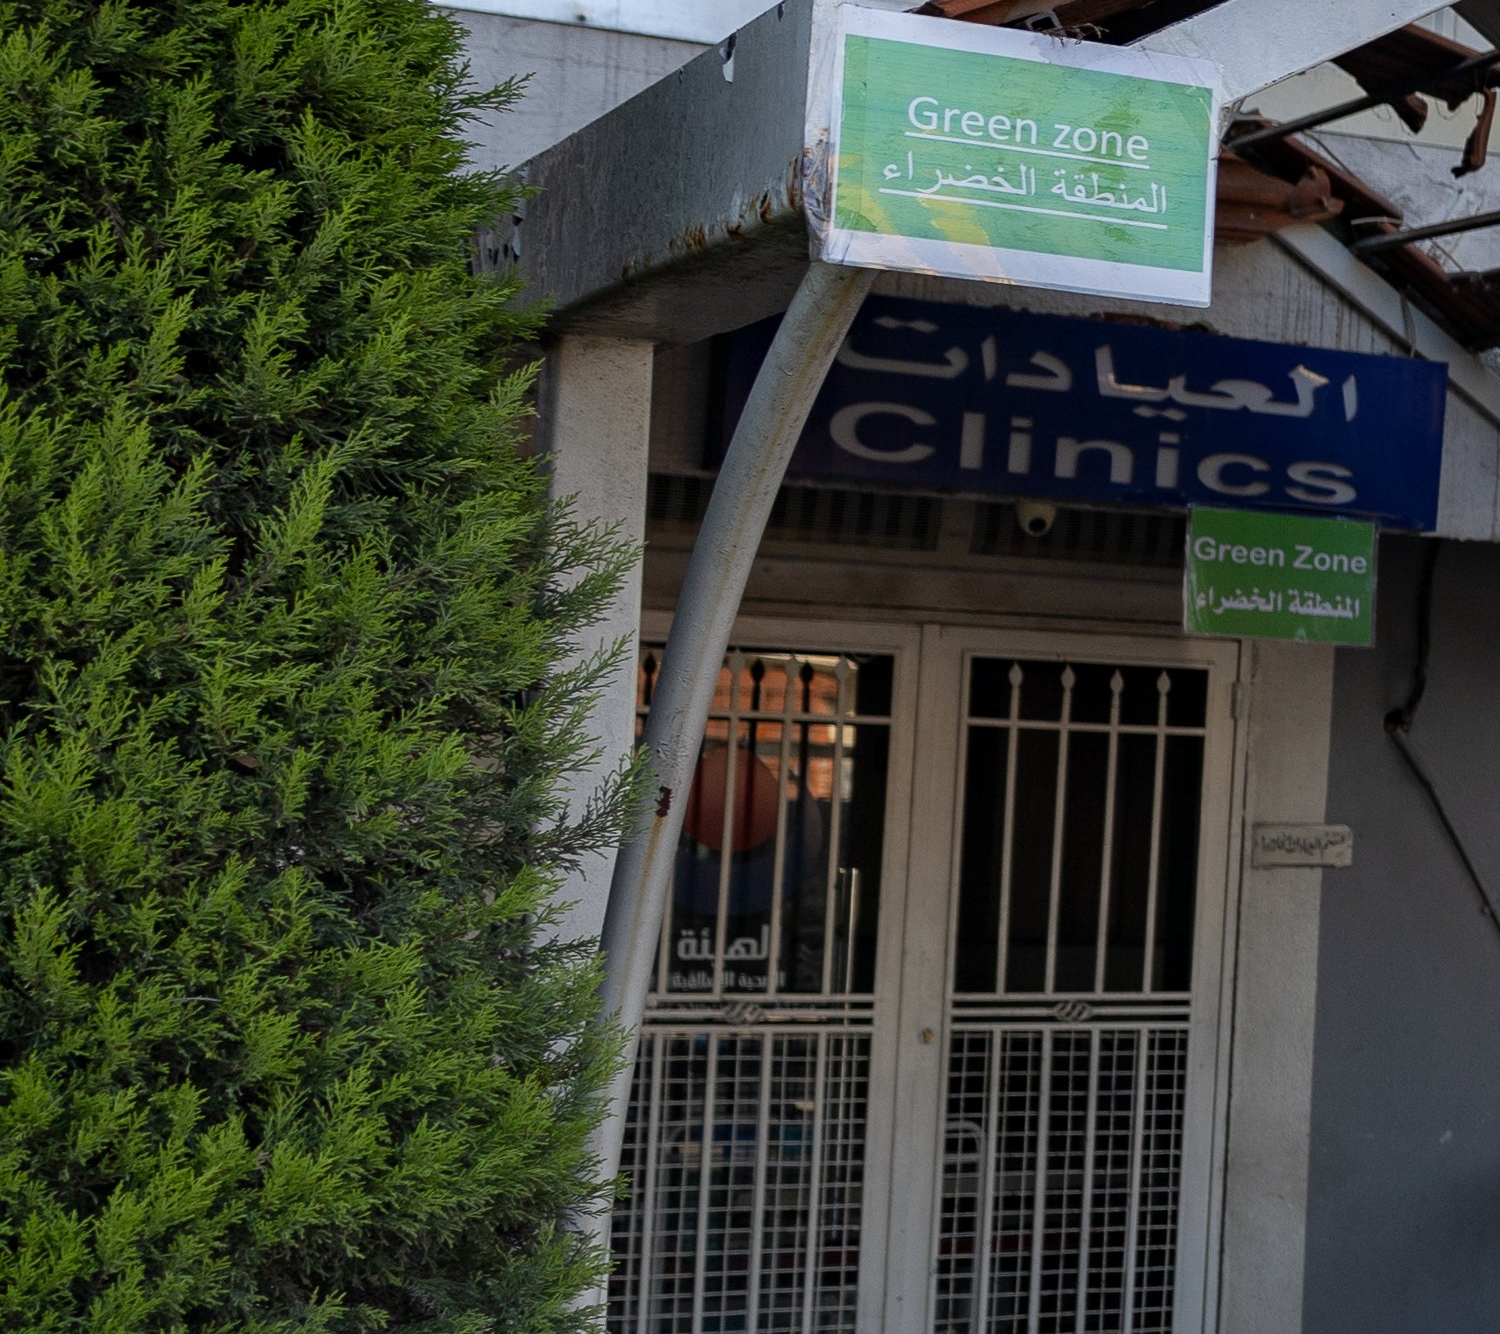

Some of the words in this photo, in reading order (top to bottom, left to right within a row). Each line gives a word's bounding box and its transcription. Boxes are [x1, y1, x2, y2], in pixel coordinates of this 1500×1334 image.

[907, 96, 1039, 146] Green
[1052, 121, 1151, 163] zone
[880, 152, 1038, 207] الخضراء
[1050, 169, 1168, 216] المنطقة
[837, 317, 1358, 423] العيادات
[829, 400, 1359, 507] Clinics
[1194, 535, 1285, 568] Green
[1294, 542, 1367, 576] Zone
[1196, 584, 1281, 616] الخضراء
[1287, 587, 1361, 621] المنطقة
